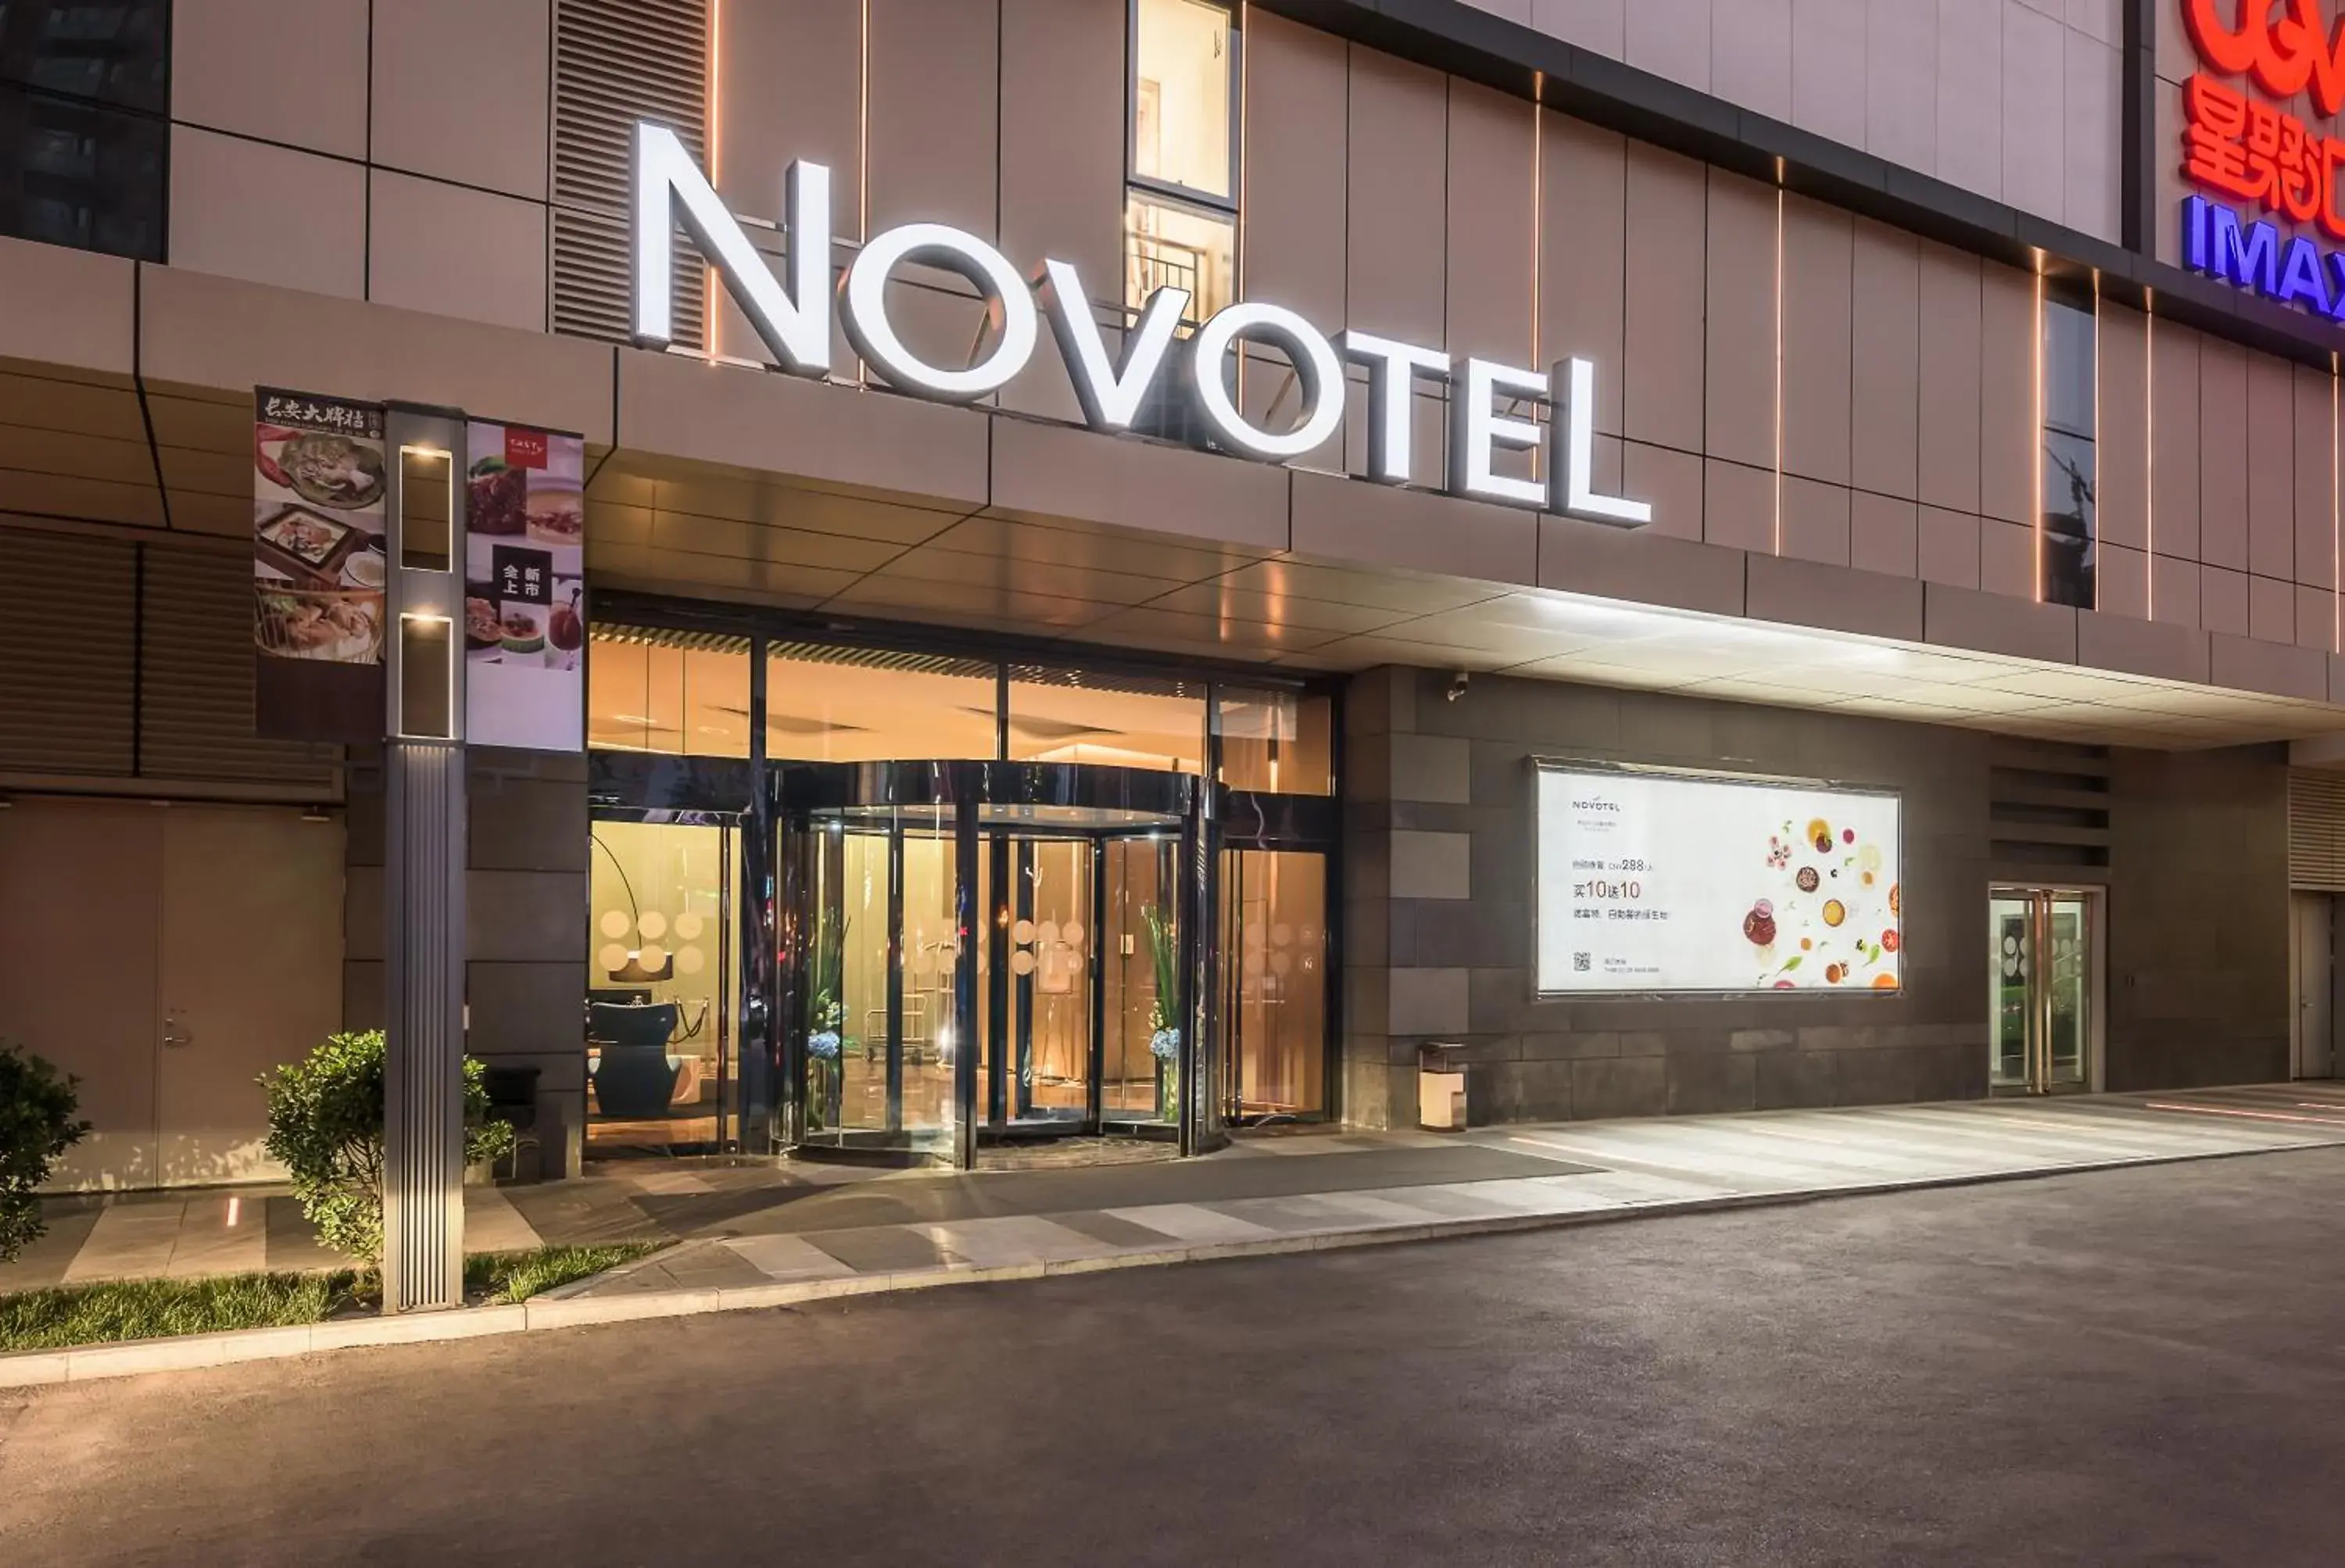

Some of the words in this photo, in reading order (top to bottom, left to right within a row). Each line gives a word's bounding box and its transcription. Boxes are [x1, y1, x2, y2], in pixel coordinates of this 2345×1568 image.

[635, 120, 1652, 525] NOVOTEL
[503, 580, 540, 596] 上市
[1572, 801, 1620, 812] NOVOTEL
